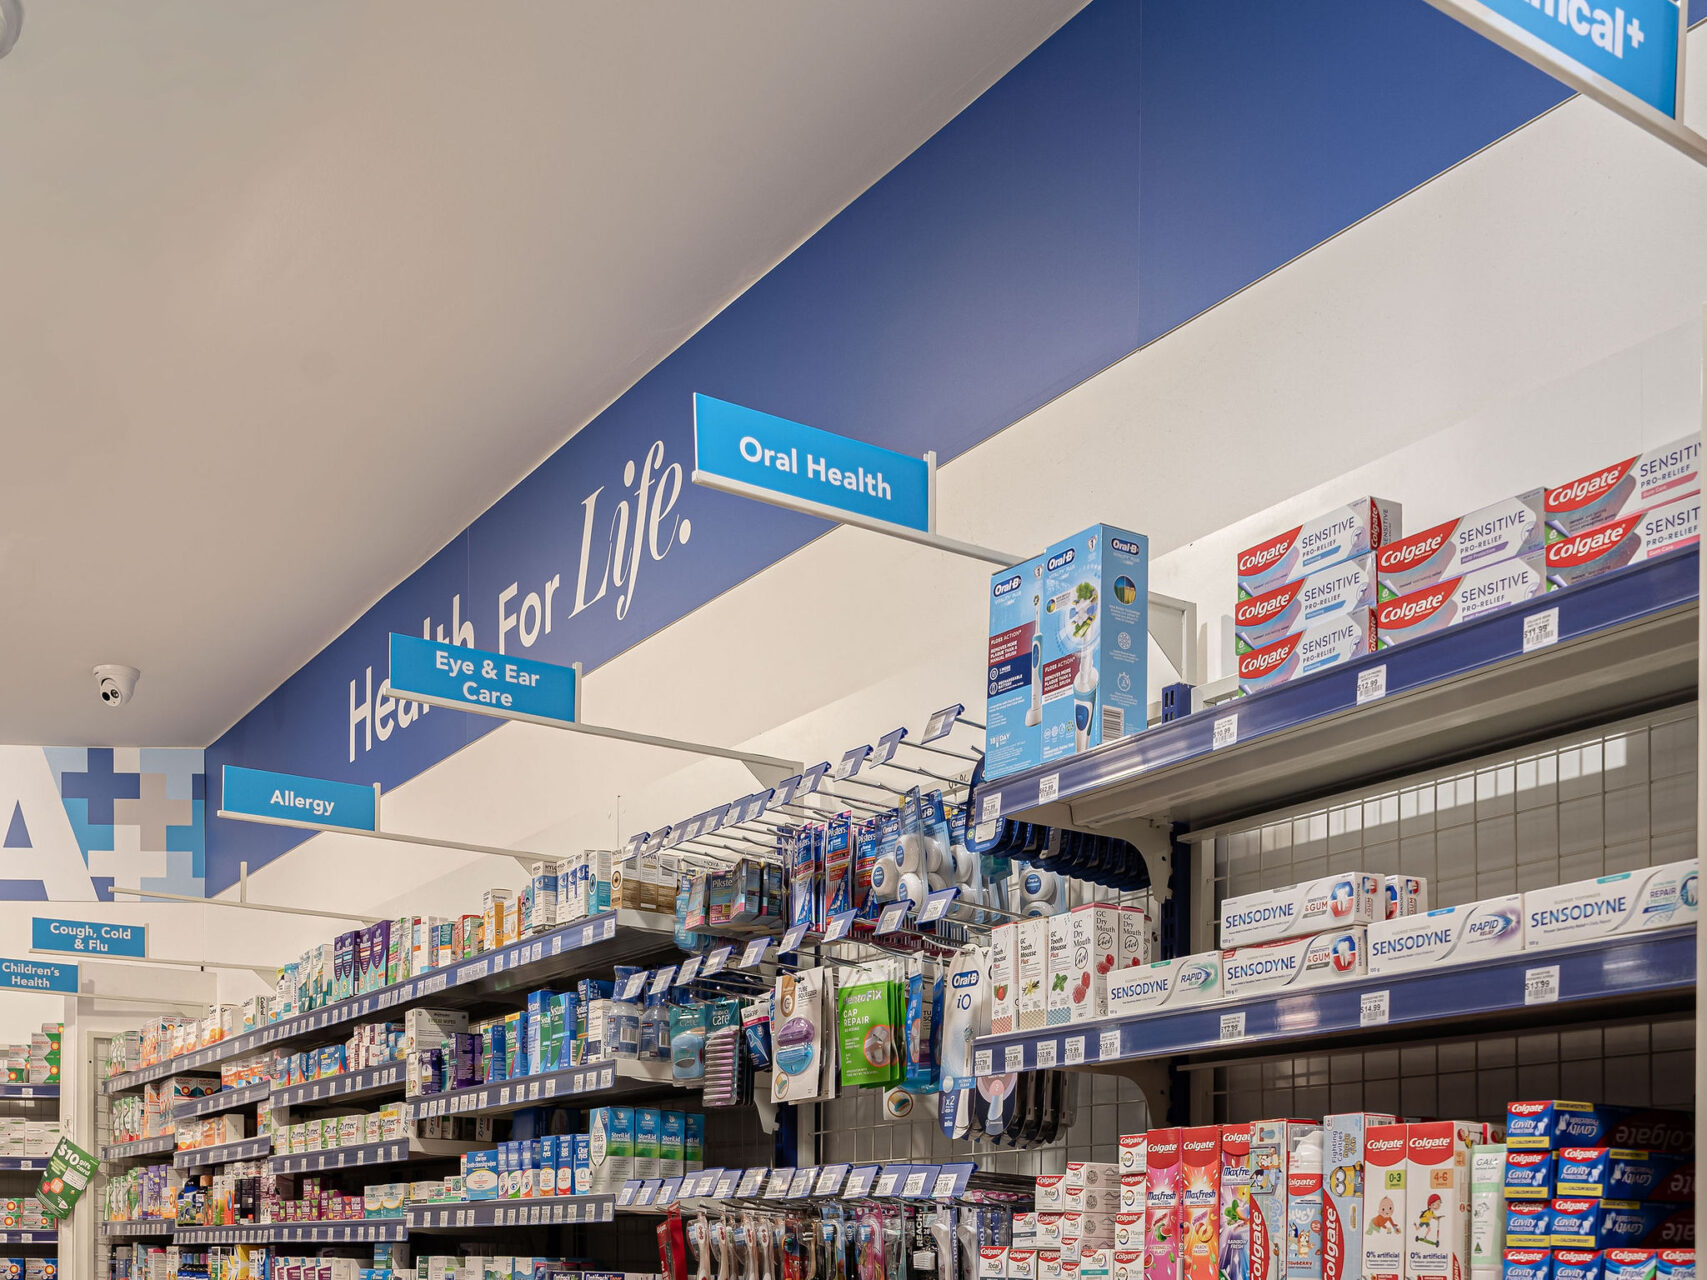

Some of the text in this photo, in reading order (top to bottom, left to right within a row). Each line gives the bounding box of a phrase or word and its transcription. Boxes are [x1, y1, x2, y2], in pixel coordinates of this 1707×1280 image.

[739, 436, 892, 500] Oral Health
[1641, 464, 1690, 488] PRO-RELIEF
[1548, 467, 1621, 506] Colgate
[1370, 507, 1379, 548] Colgate
[1240, 517, 1354, 571] Colgate SENSITIVE
[1380, 510, 1525, 567] Colgate SENSITIVE
[1549, 524, 1626, 560] Colgate
[498, 574, 561, 655] For
[568, 440, 692, 621] Life.
[1112, 539, 1140, 554] Oral-B
[1048, 550, 1074, 570] Oral-B
[994, 576, 1021, 596] Oral-B
[1239, 572, 1360, 622] Colgate SENSITIVE
[1380, 571, 1529, 623] Colgate SENSITIVE
[1241, 625, 1354, 672] Colgate SENSITIVE
[435, 651, 540, 688] Eye & Ear
[462, 682, 513, 707] Care
[270, 789, 335, 816] Allergy
[1650, 887, 1677, 898] REPAIR
[1226, 903, 1294, 929] SENSODYNE
[1531, 897, 1626, 928] SENSODYNE
[1073, 921, 1082, 929] GC
[1096, 918, 1107, 927] Dry
[1123, 921, 1134, 929] Dry
[1469, 919, 1499, 933] RAPID
[50, 923, 131, 939] Cough, Cold
[1073, 930, 1083, 940] Dry
[1096, 925, 1115, 934] Mouth
[1123, 928, 1142, 936] Mouth
[74, 939, 108, 951] & Flu
[1372, 929, 1451, 956] SENSODYNE
[2, 962, 60, 976] Children's
[1227, 956, 1296, 980] SENSODYNE
[11, 976, 50, 988] Health
[953, 971, 978, 987] Oral-B
[1180, 972, 1202, 983] RAPID
[1111, 979, 1168, 1000] SENSODYNE
[843, 1009, 857, 1018] CAP
[844, 1016, 869, 1026] REPAIR
[1511, 1103, 1544, 1114] Colgate
[1511, 1120, 1536, 1130] Cavity
[1148, 1143, 1178, 1154] Colgate
[1183, 1141, 1216, 1152] Colgate
[1367, 1139, 1403, 1150] Colgate
[1409, 1137, 1450, 1148] Colgate
[58, 1144, 79, 1165] $10
[1508, 1153, 1541, 1164] Colgate
[1564, 1149, 1599, 1161] Colgate
[1390, 1173, 1401, 1182] 0-3
[1434, 1172, 1447, 1181] 4-6
[1556, 1201, 1589, 1211] Colgate
[1410, 1251, 1448, 1260] 0% artificial
[1508, 1251, 1542, 1262] Colgate
[1557, 1252, 1591, 1263] Colgate
[1610, 1249, 1648, 1262] Colgate
[1620, 1270, 1645, 1280] Triple
